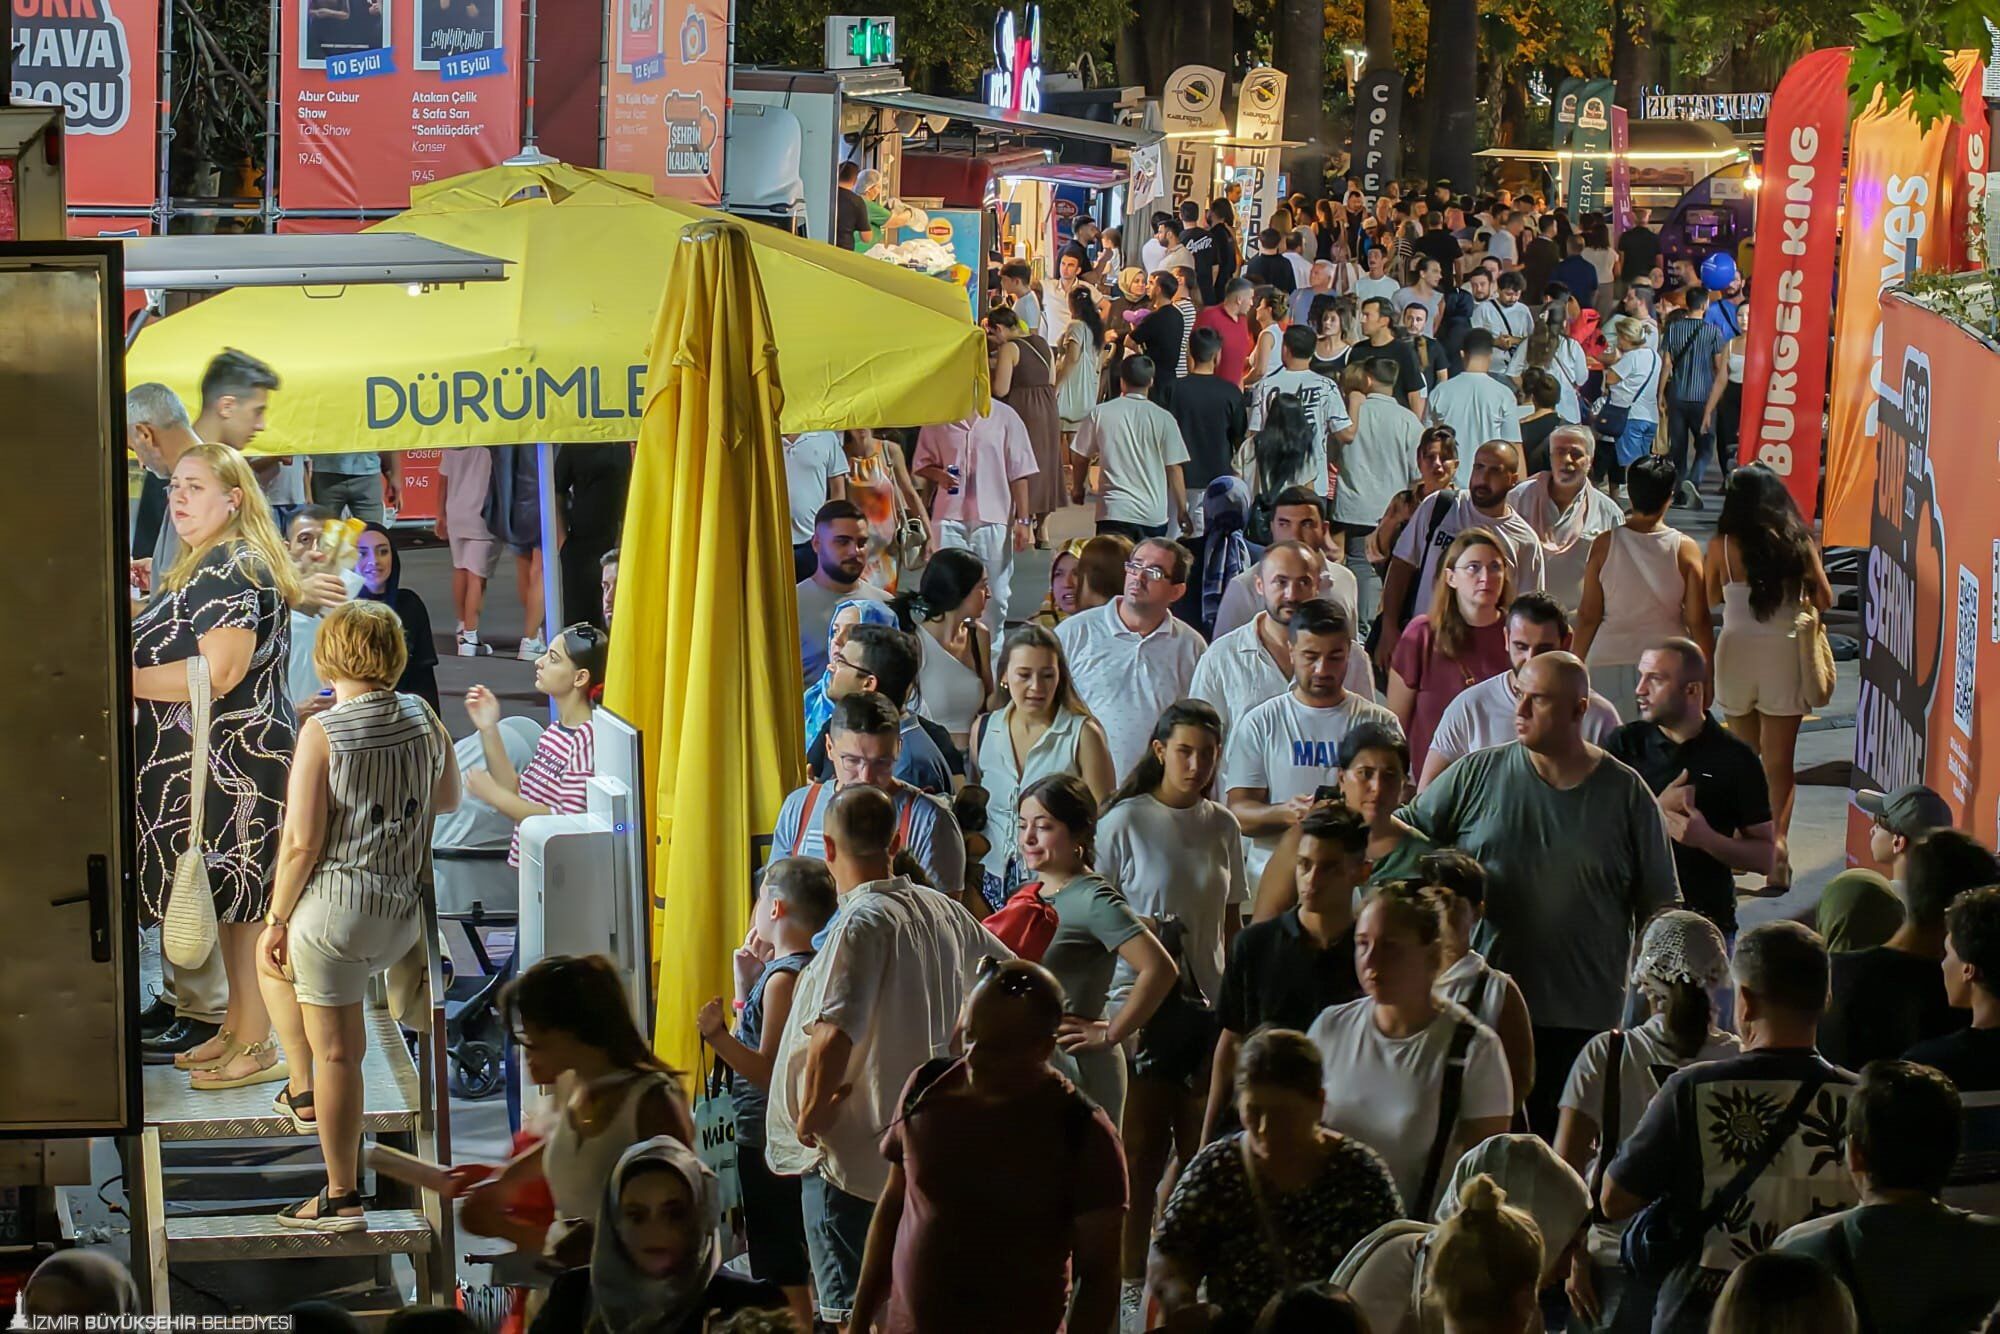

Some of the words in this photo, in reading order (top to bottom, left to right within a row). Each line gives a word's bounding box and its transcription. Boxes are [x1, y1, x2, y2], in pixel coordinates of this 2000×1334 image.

[332, 60, 348, 76] 10
[349, 54, 382, 75] Eylül
[446, 64, 458, 76] 11
[460, 56, 491, 75] Eylül
[297, 90, 324, 103] Abur
[326, 90, 360, 103] Cubur
[412, 91, 449, 103] Atakan
[451, 91, 478, 106] Çelik
[297, 106, 327, 119] Show
[412, 108, 421, 119] &
[422, 108, 448, 119] Safa
[297, 123, 320, 136] Talk
[321, 123, 351, 136] Show
[671, 121, 702, 147] ŞEHRİN
[412, 141, 446, 152] Konser
[668, 146, 709, 171] KALBİNDE
[1578, 142, 1596, 214] KEBAPI
[1758, 269, 1804, 477] BURGER
[1782, 126, 1819, 256] KING
[1865, 540, 1915, 677] ŞEHRİN
